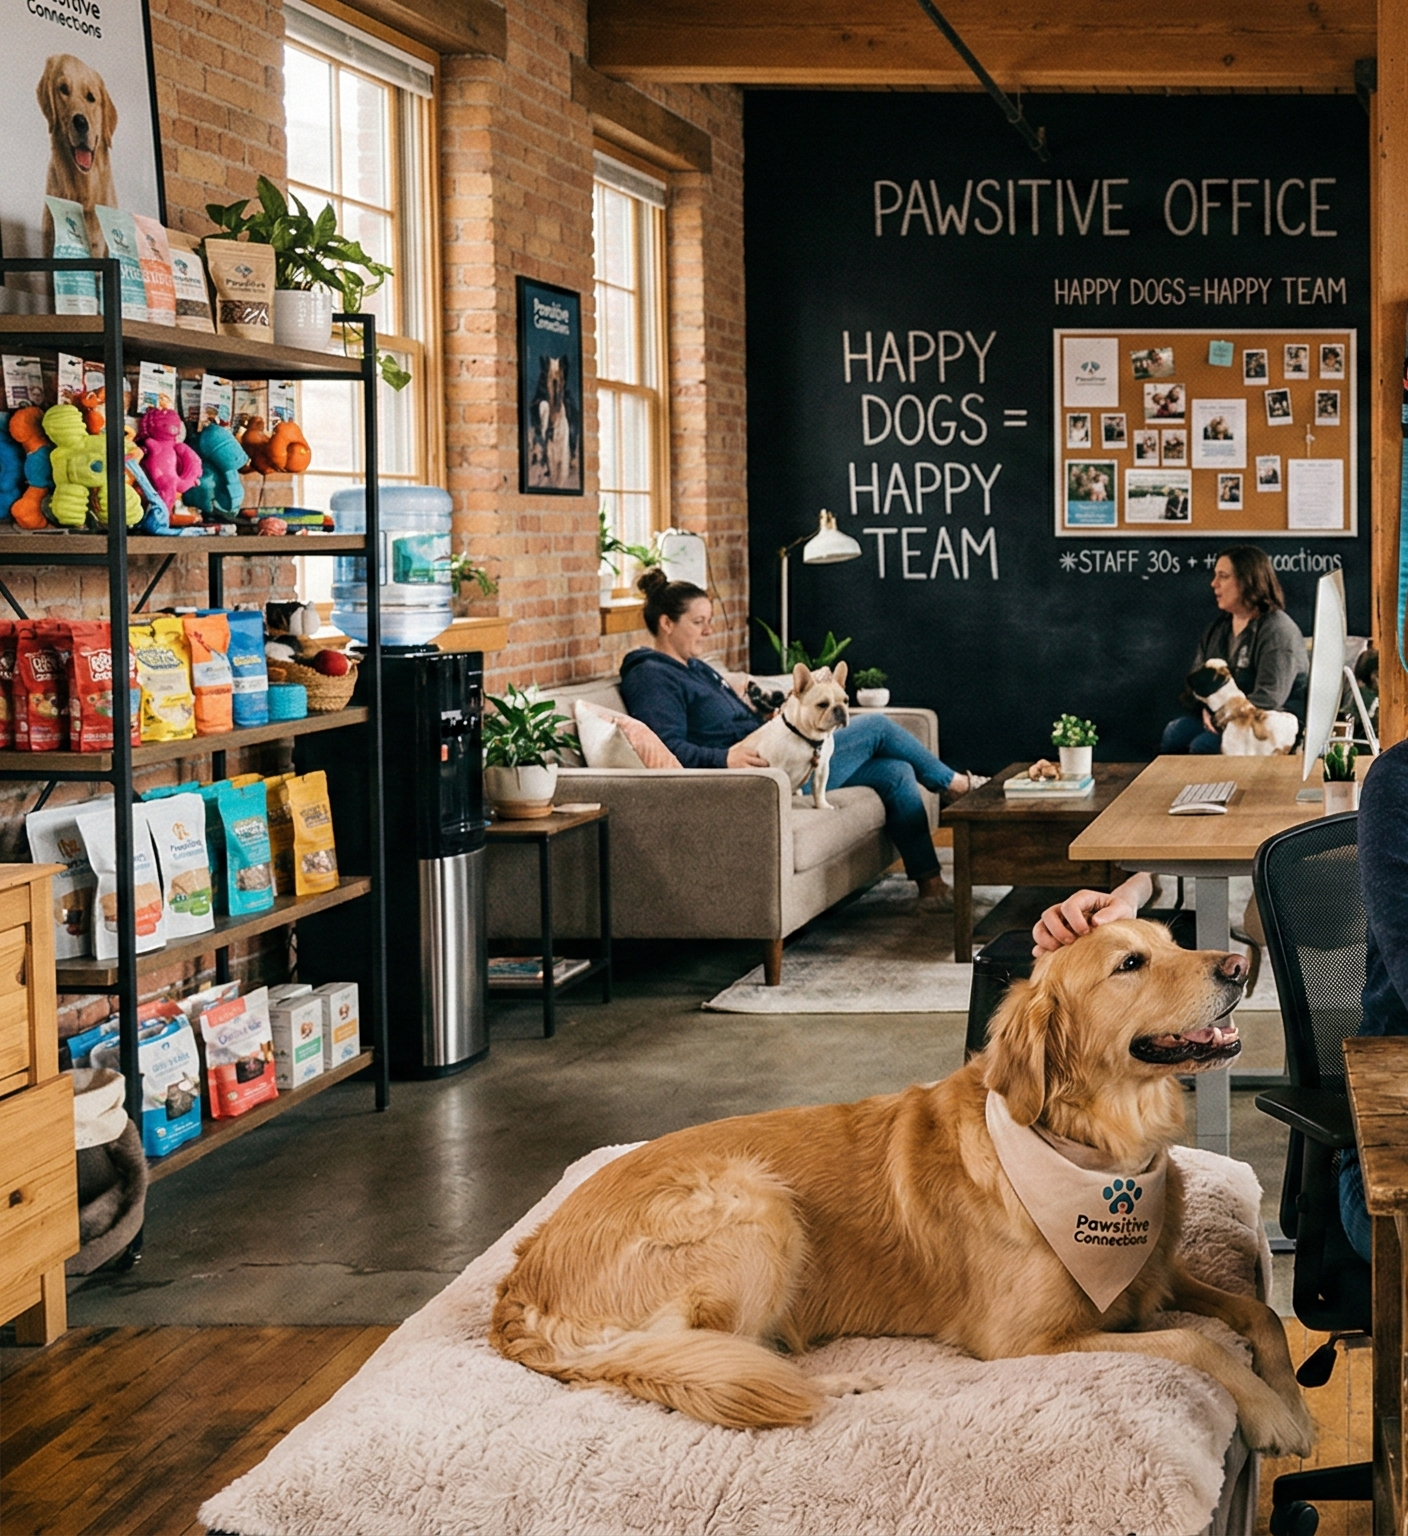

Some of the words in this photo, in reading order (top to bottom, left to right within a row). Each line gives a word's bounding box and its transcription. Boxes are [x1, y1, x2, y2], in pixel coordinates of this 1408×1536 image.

[27, 0, 102, 39] Connectons
[874, 178, 1130, 237] PAWSITIVE
[1164, 178, 1338, 237] OFFICE
[1054, 278, 1122, 305] HAPPY
[1281, 277, 1347, 306] TEAM
[842, 330, 997, 384] HAPPY
[862, 393, 989, 447] DOGS
[848, 462, 1003, 517] HAPPY
[863, 526, 1000, 581] TEAM
[1076, 1214, 1149, 1233] Pawsitive
